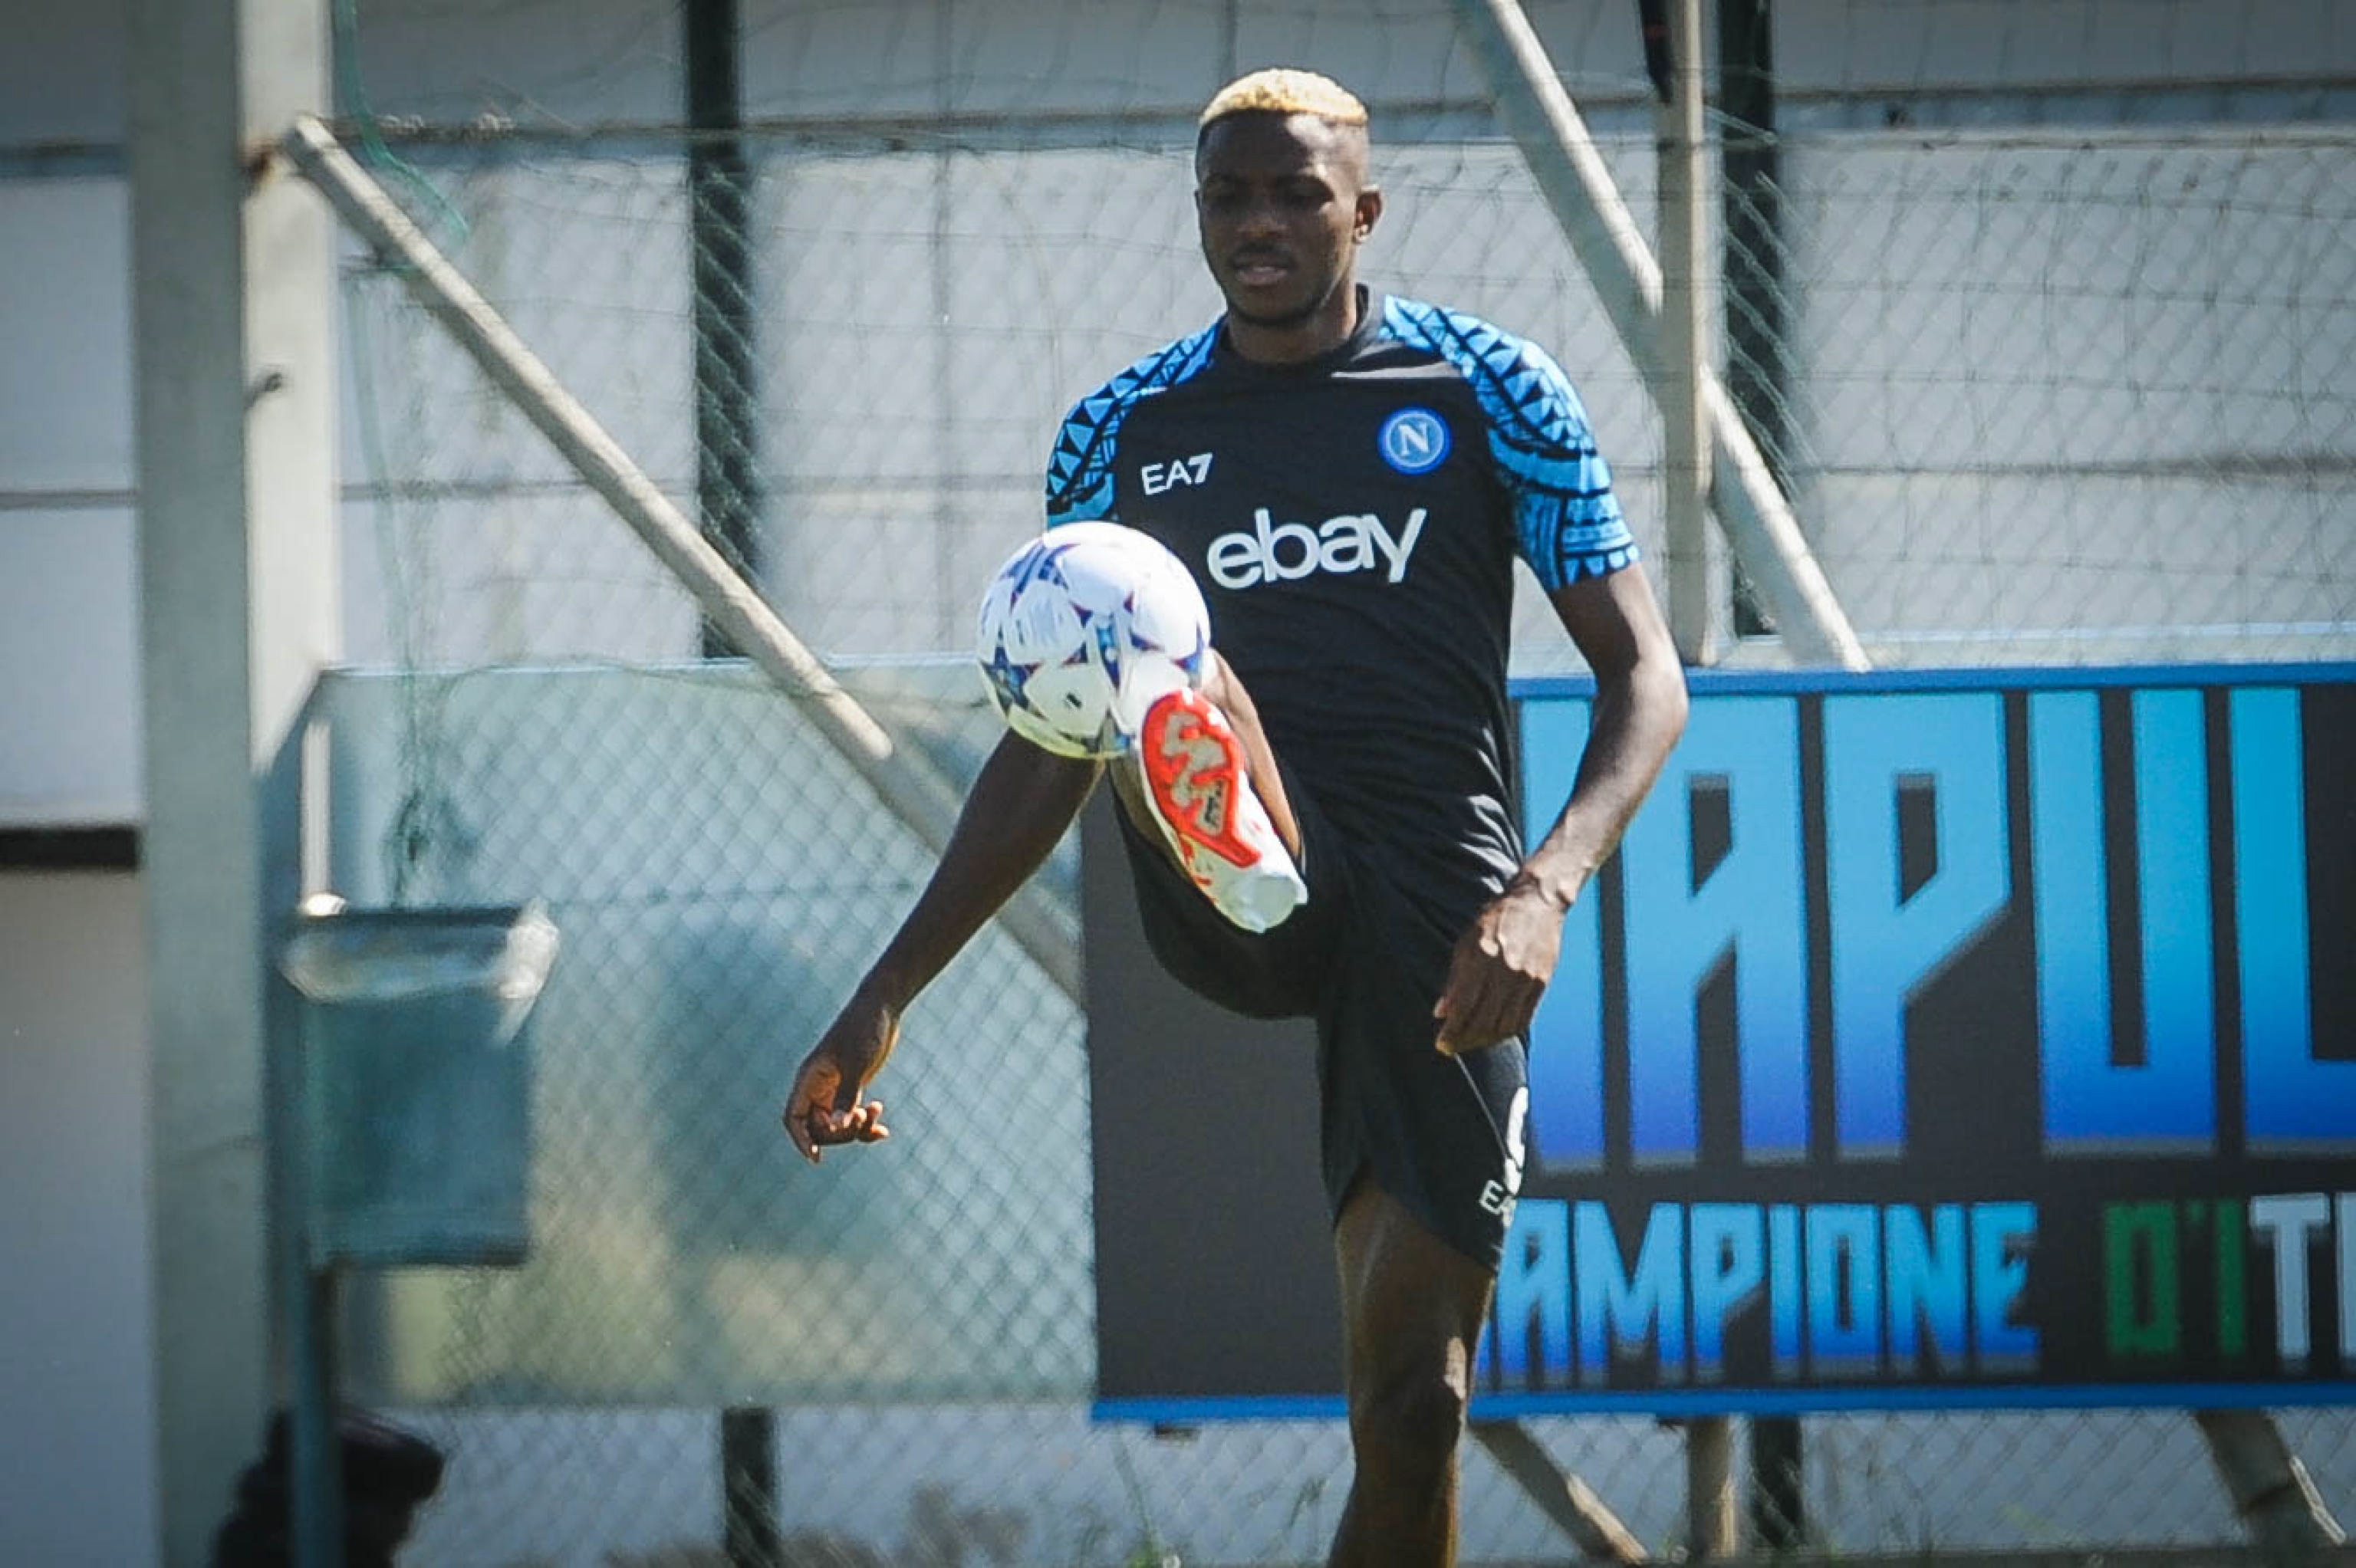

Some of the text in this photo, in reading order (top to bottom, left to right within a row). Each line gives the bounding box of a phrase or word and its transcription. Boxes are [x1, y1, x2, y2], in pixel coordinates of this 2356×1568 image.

[1398, 421, 1430, 455] N
[1141, 452, 1213, 495] EA7
[1207, 508, 1427, 589] ebay
[1475, 1199, 2040, 1383] AMPIONE
